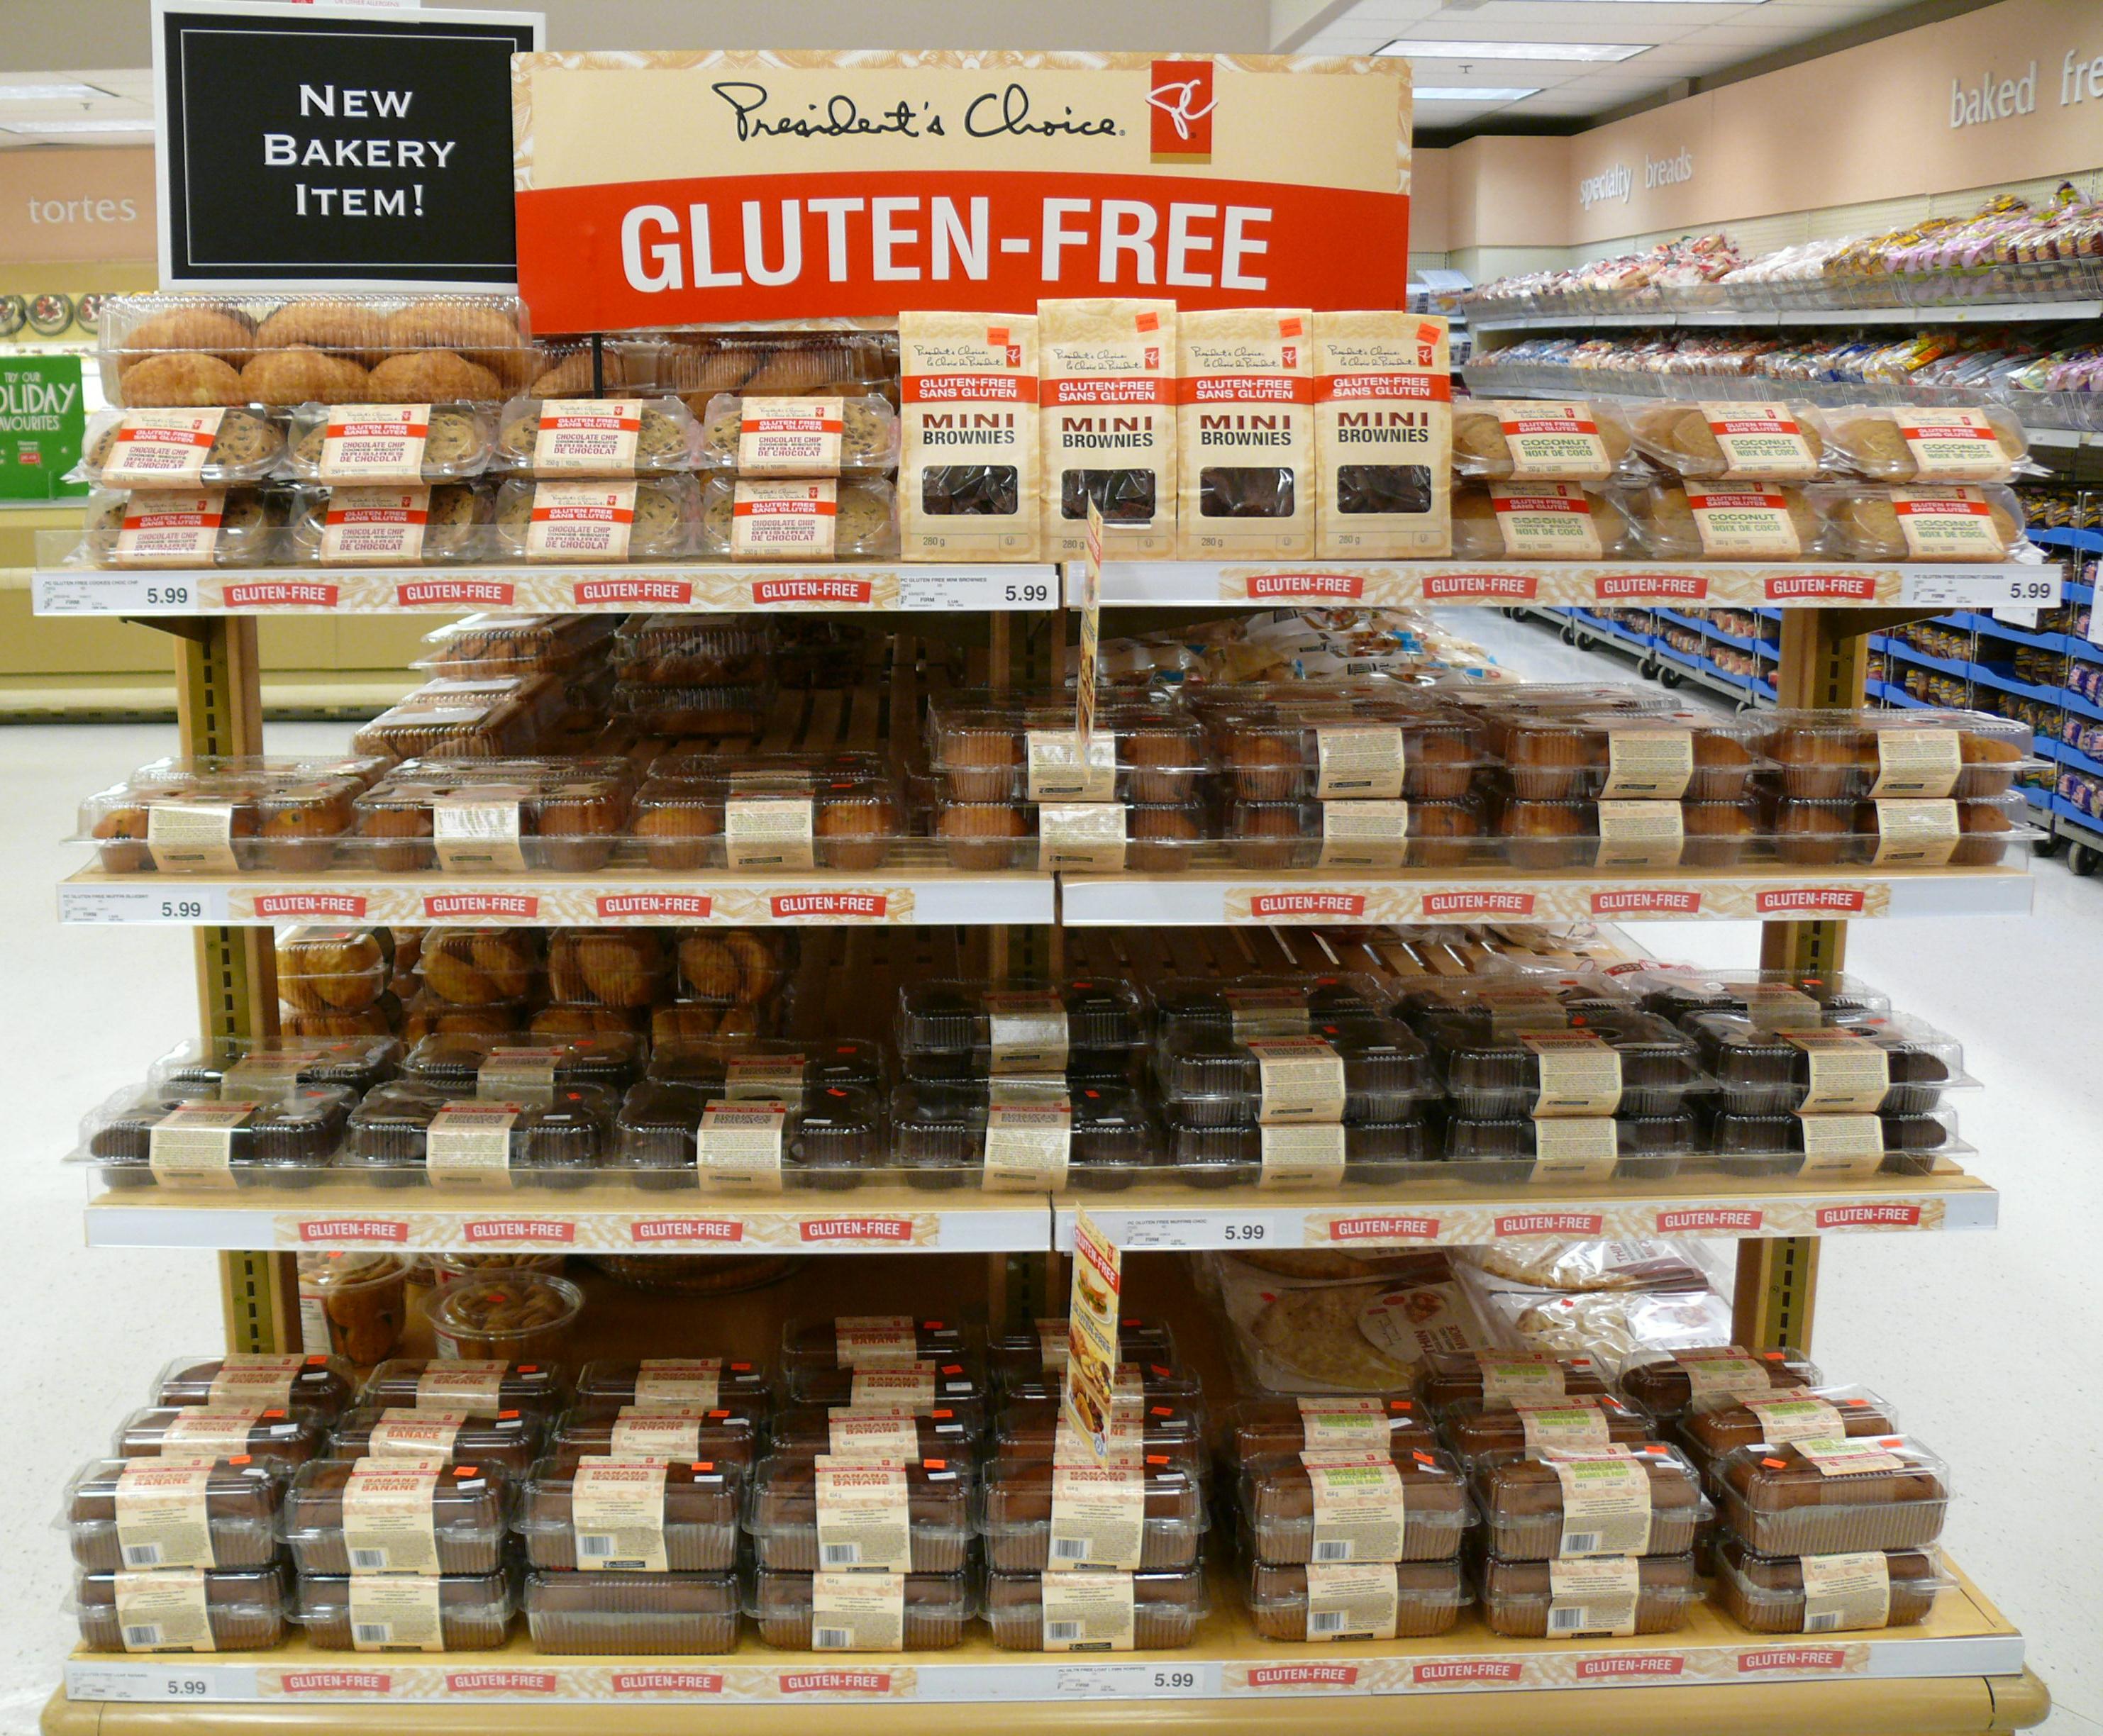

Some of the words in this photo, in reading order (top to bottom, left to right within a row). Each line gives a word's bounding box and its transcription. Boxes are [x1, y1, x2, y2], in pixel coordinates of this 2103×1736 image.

[299, 85, 412, 118] NEW
[1951, 61, 2036, 128] baked
[711, 82, 944, 143] President's
[263, 134, 456, 167] BAKERY
[1580, 165, 1633, 210] specialty
[1645, 148, 1693, 189] breads
[296, 184, 424, 216] ITEM!
[28, 196, 135, 223] tortes
[621, 197, 1272, 291] GLUTEN-FREE
[4, 372, 18, 383] TRY
[22, 372, 41, 382] OUR
[920, 377, 1016, 389] GLUTEN-FREE
[1197, 379, 1292, 389] GLUTEN-FREE
[1333, 377, 1429, 388] GLUTEN-FREE
[919, 388, 957, 399] SANS
[961, 388, 1016, 399] GLUTEN
[1059, 381, 1155, 392] GLUTEN-FREE
[1196, 389, 1234, 399] SANS
[1238, 389, 1293, 399] GLUTEN
[1333, 387, 1370, 397] SANS
[1376, 386, 1430, 397] GLUTEN
[1059, 391, 1096, 401] SANS
[1100, 391, 1155, 401] GLUTEN
[923, 413, 1014, 429] MINI
[1062, 416, 1153, 433] MINI
[1200, 415, 1291, 430] MINI
[1338, 412, 1428, 427] MINI
[923, 430, 1015, 445] BROWNIES
[1062, 433, 1153, 448] BROWNIES
[1201, 431, 1292, 445] BROWNIES
[1338, 428, 1428, 443] BROWNIES
[923, 537, 938, 546] 280
[940, 538, 945, 547] g
[1062, 540, 1077, 549] 280
[1079, 541, 1084, 550] g
[1201, 537, 1216, 546] 280
[1218, 539, 1223, 547] g
[1338, 535, 1354, 544] 280
[1355, 537, 1360, 545] g
[231, 584, 326, 602] GLUTEN-FREE
[406, 583, 502, 601] GLUTEN-FREE
[583, 582, 680, 599] GLUTEN-FREE
[762, 582, 859, 599] GLUTEN-FREE
[1005, 585, 1047, 601] 5.99
[1255, 577, 1352, 593] GLUTEN-FREE
[1431, 577, 1526, 594] GLUTEN-FREE
[1604, 578, 1697, 594] GLUTEN-FREE
[1773, 578, 1864, 594] GLUTEN-FREE
[2010, 583, 2051, 599] 5.99
[147, 587, 188, 603] 5.99
[262, 896, 355, 913] GLUTEN-FREE
[433, 896, 527, 913] GLUTEN-FREE
[605, 896, 700, 913] GLUTEN-FREE
[779, 896, 875, 912] GLUTEN-FREE
[1260, 896, 1353, 911] GLUTEN-FREE
[1431, 894, 1524, 911] GLUTEN-FREE
[1599, 892, 1690, 909] GLUTEN-FREE
[1764, 891, 1853, 908] GLUTEN-FREE
[161, 901, 201, 917] 5.99
[1503, 1215, 1591, 1232] GLUTEN-FREE
[1665, 1212, 1751, 1229] GLUTEN-FREE
[1824, 1207, 1911, 1225] GLUTEN-FREE
[307, 1223, 396, 1237] GLUTEN-FREE
[473, 1222, 563, 1237] GLUTEN-FREE
[640, 1222, 731, 1237] GLUTEN-FREE
[809, 1220, 901, 1237] GLUTEN-FREE
[1225, 1225, 1265, 1240] 5.99
[1338, 1219, 1428, 1235] GLUTEN-FREE
[1585, 1658, 1672, 1675] GLUTEN-FREE
[1746, 1652, 1833, 1669] GLUTEN-FREE
[1256, 1667, 1347, 1684] GLUTEN-FREE
[1421, 1663, 1510, 1679] GLUTEN-FREE
[167, 1680, 206, 1694] 5.99
[289, 1675, 379, 1689] GLUTEN-FREE
[455, 1674, 543, 1689] GLUTEN-FREE
[621, 1674, 711, 1689] GLUTEN-FREE
[788, 1674, 878, 1689] GLUTEN-FREE
[1154, 1672, 1194, 1688] 5.99
